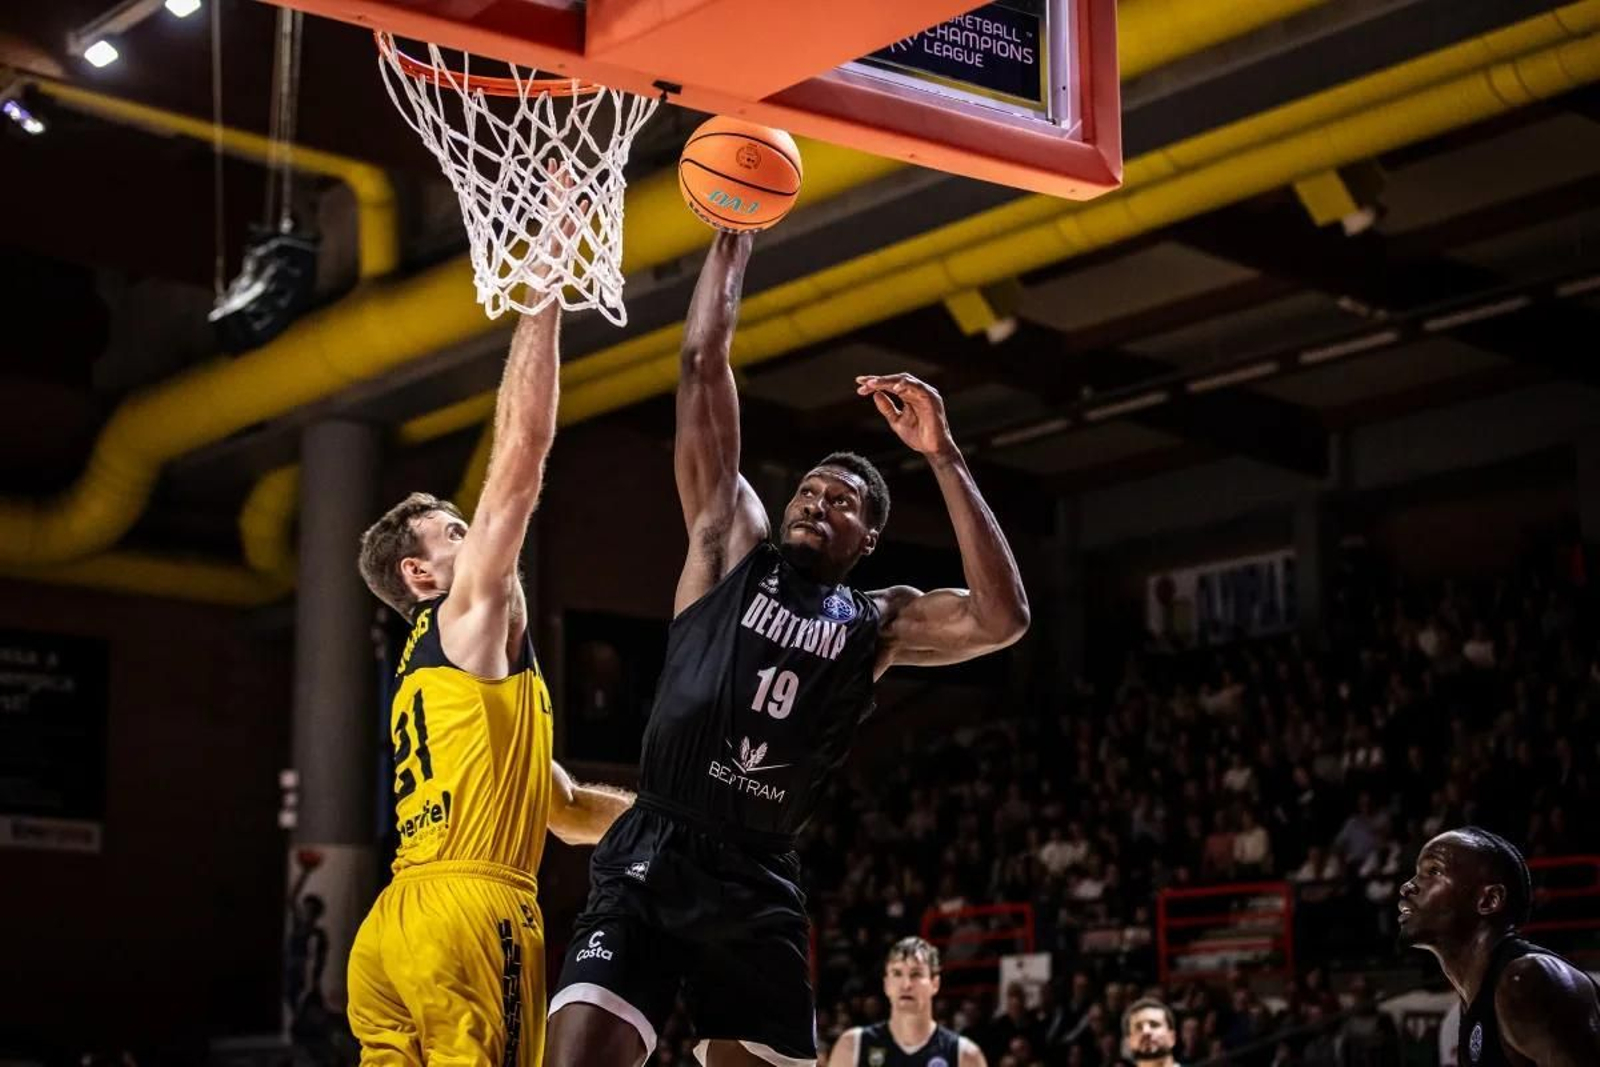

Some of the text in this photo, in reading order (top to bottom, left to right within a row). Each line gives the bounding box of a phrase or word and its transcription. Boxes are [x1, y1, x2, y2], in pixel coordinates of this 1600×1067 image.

[923, 38, 985, 68] LEAGUE
[751, 666, 800, 720] 19
[708, 760, 786, 803] BERTRAM
[576, 946, 613, 963] Costa
